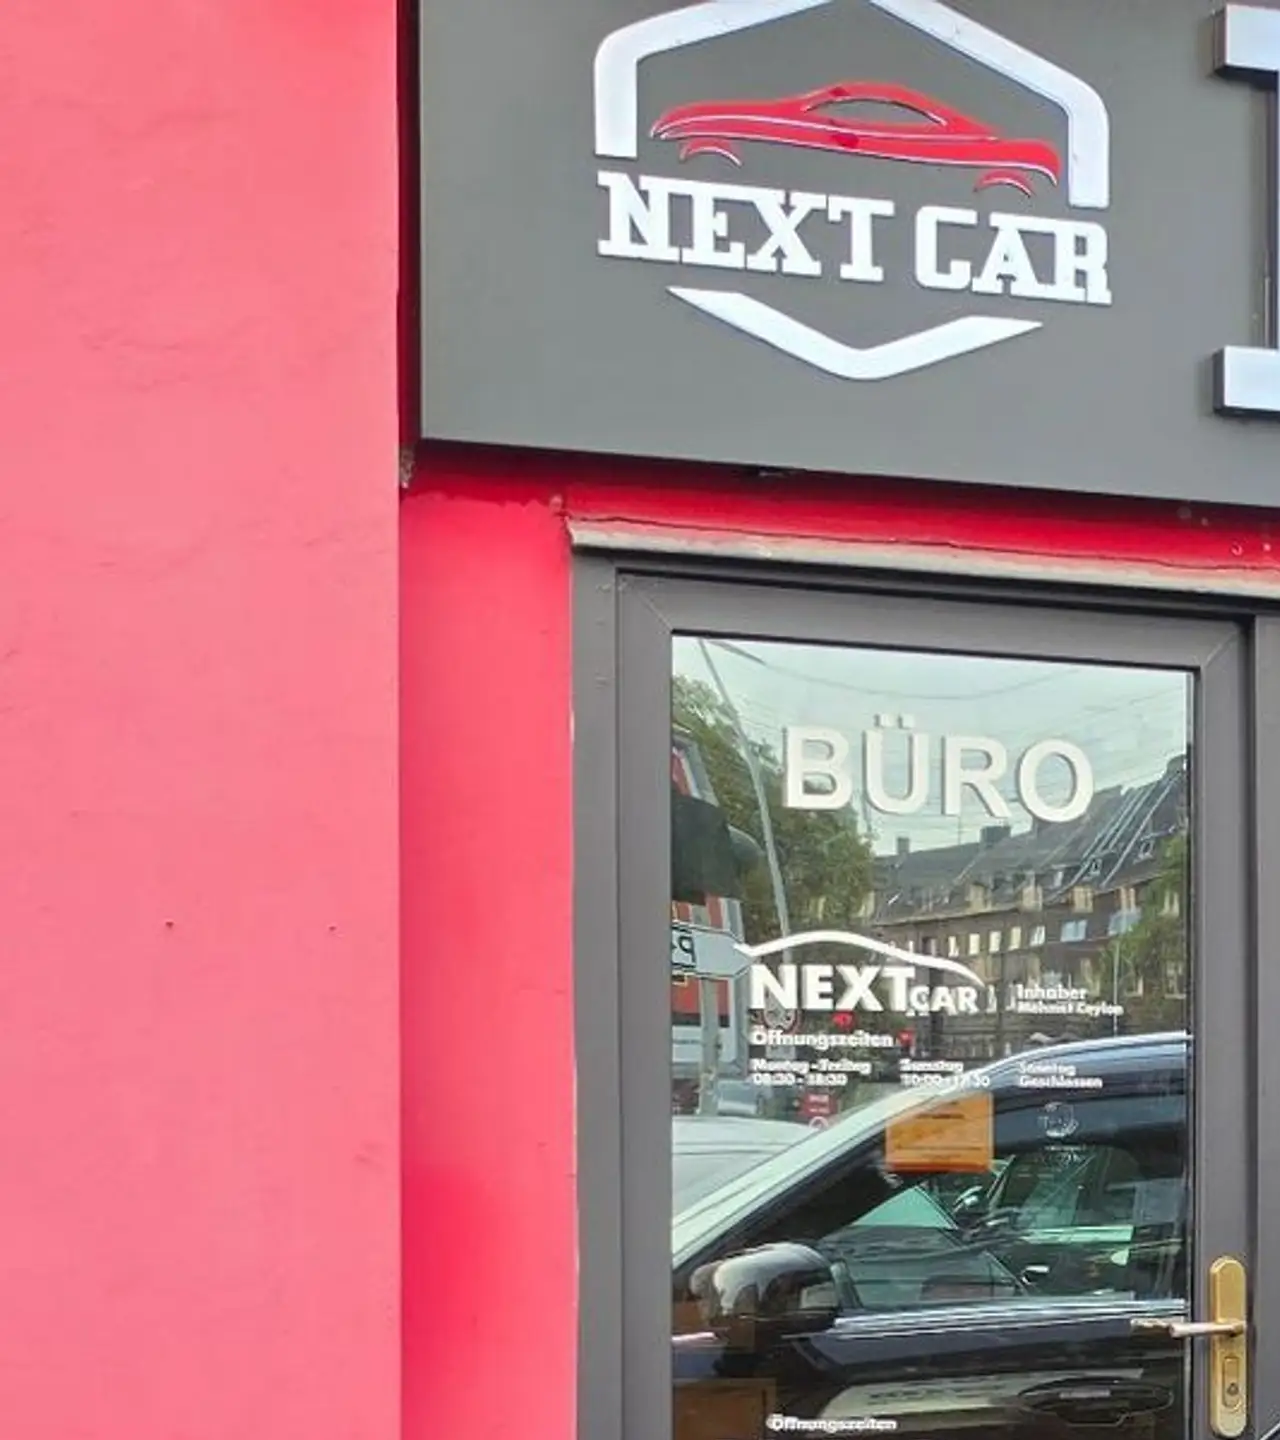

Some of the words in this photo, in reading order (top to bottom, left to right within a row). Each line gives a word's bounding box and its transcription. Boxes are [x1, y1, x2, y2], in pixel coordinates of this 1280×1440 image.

[597, 171, 895, 283] NEXT
[914, 205, 1112, 306] CAR
[784, 713, 1096, 824] BÜRO
[1017, 983, 1088, 1000] Inhaber
[750, 1026, 894, 1050] Öffnungszeiten
[1018, 1075, 1103, 1089] Geschlossen
[765, 1413, 898, 1433] Öffnungszeiten
